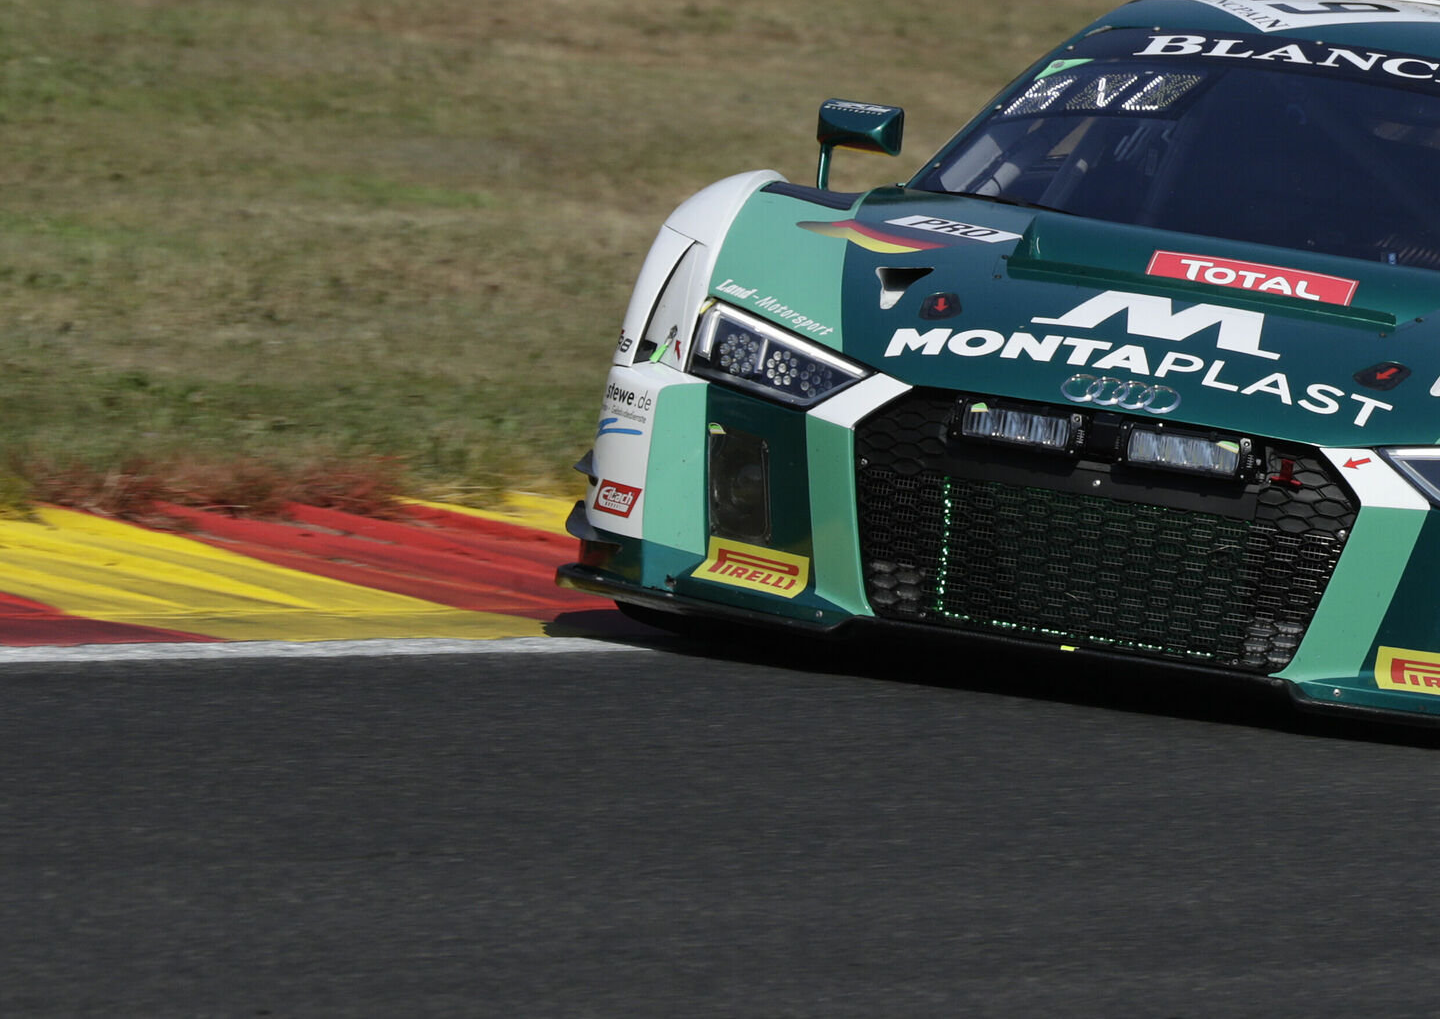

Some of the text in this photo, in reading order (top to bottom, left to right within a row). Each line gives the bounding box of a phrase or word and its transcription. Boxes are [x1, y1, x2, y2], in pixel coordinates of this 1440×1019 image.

[908, 218, 996, 238] PRO
[1179, 258, 1321, 301] TOTAL
[884, 327, 1394, 428] MONTAPLAST
[598, 486, 634, 513] Eibach
[707, 548, 800, 590] PIRELLI
